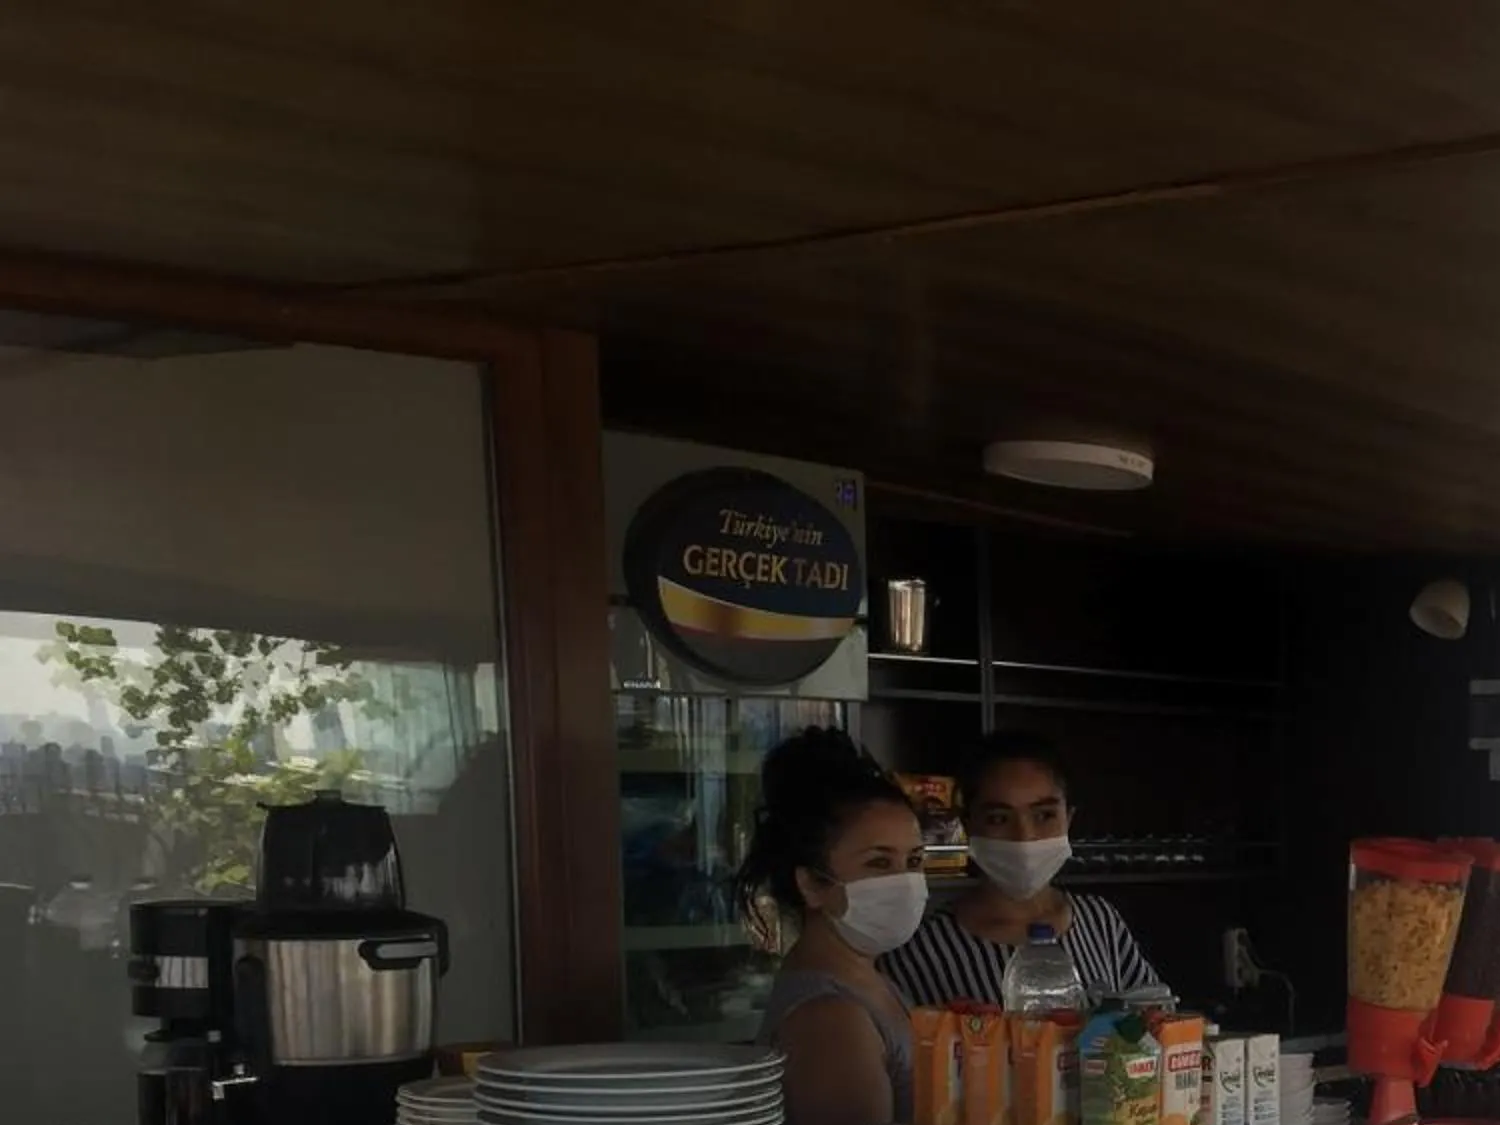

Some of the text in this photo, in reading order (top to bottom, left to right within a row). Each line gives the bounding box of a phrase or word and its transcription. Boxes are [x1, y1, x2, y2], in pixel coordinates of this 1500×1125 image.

[719, 508, 823, 549] Türkiye'nin
[682, 544, 849, 591] GERÇEK TADI
